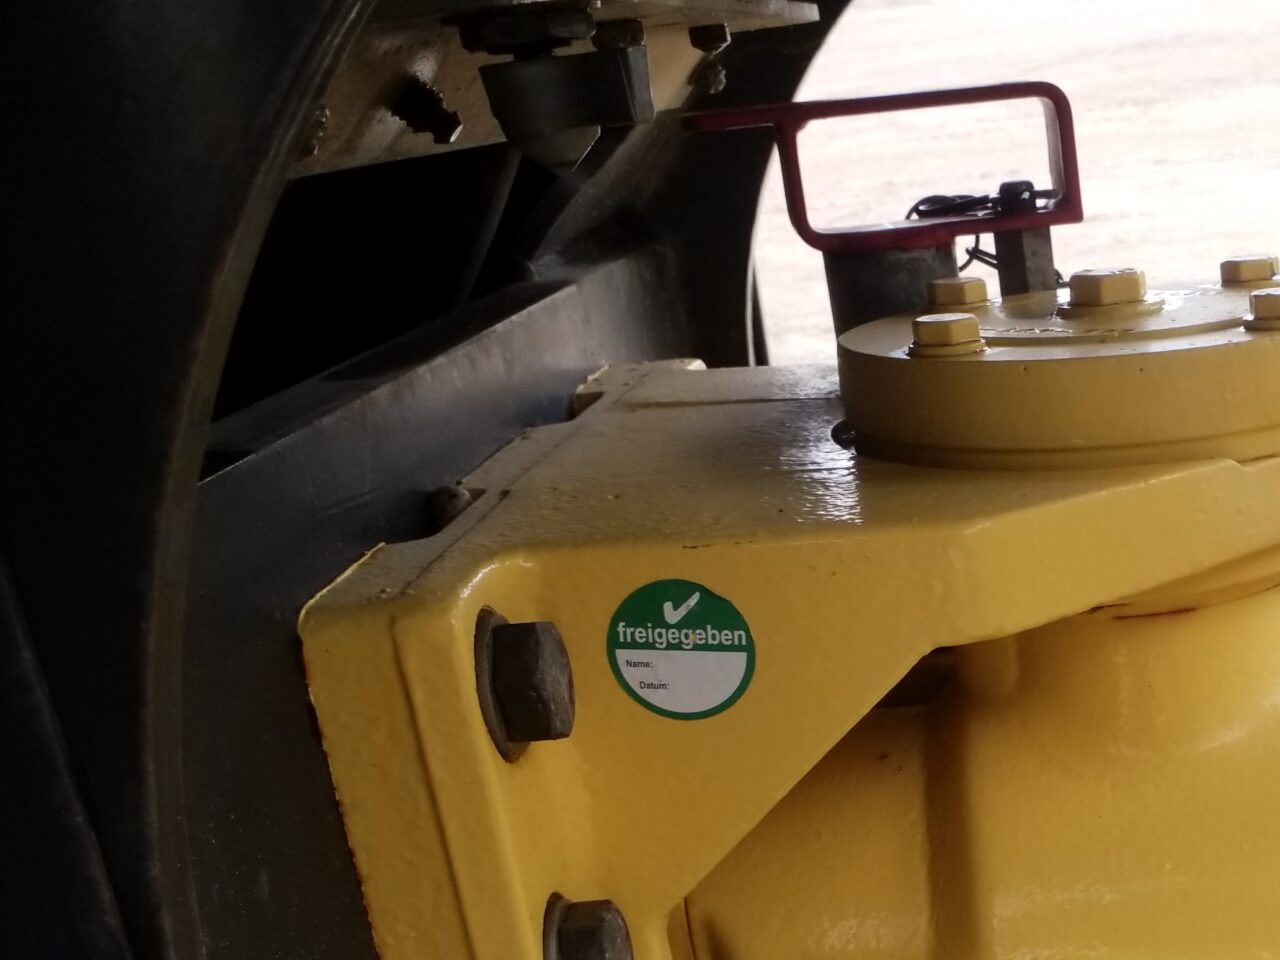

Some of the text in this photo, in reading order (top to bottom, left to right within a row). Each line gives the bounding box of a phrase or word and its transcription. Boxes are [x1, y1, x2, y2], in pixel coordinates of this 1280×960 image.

[617, 622, 747, 649] freigegeben
[626, 659, 654, 669] Name:
[639, 680, 670, 690] Datum:
